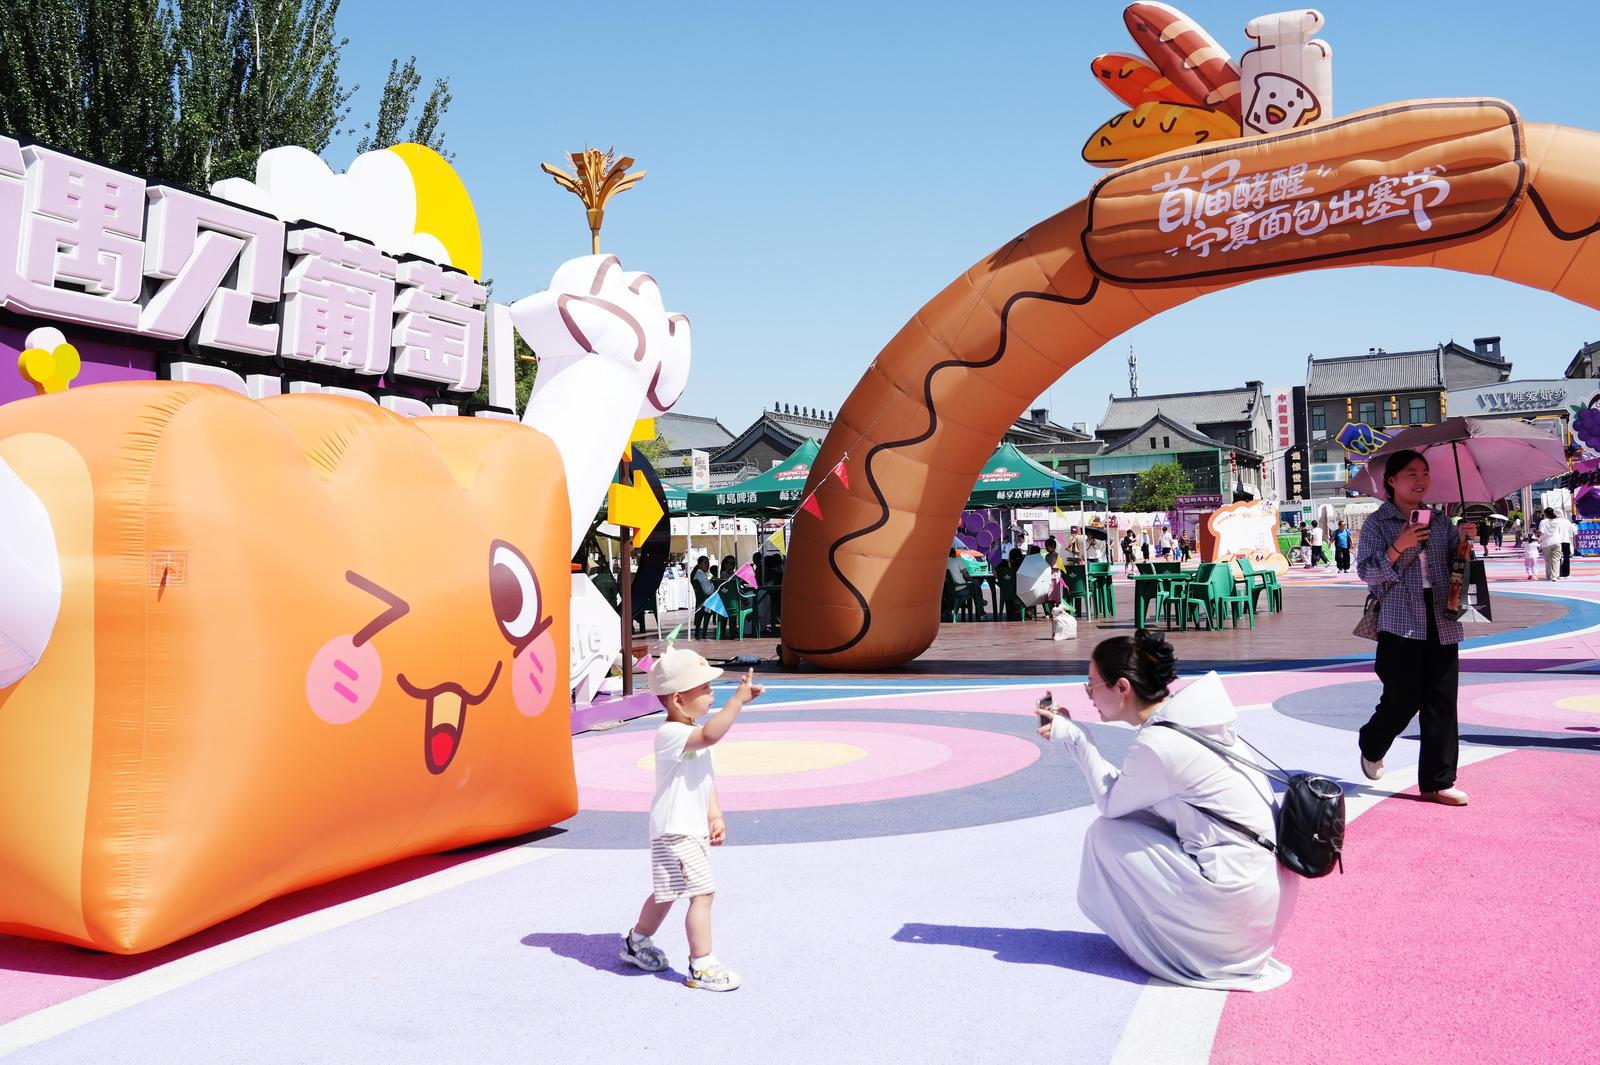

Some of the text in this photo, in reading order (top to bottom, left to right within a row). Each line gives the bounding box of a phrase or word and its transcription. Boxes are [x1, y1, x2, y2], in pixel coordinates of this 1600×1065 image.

[1151, 159, 1314, 233] 首届酵醒
[1185, 164, 1451, 257] 宁夏面包出塞节
[715, 491, 758, 506] 青岛啤酒
[996, 488, 1051, 500] 畅享欢聚时刻
